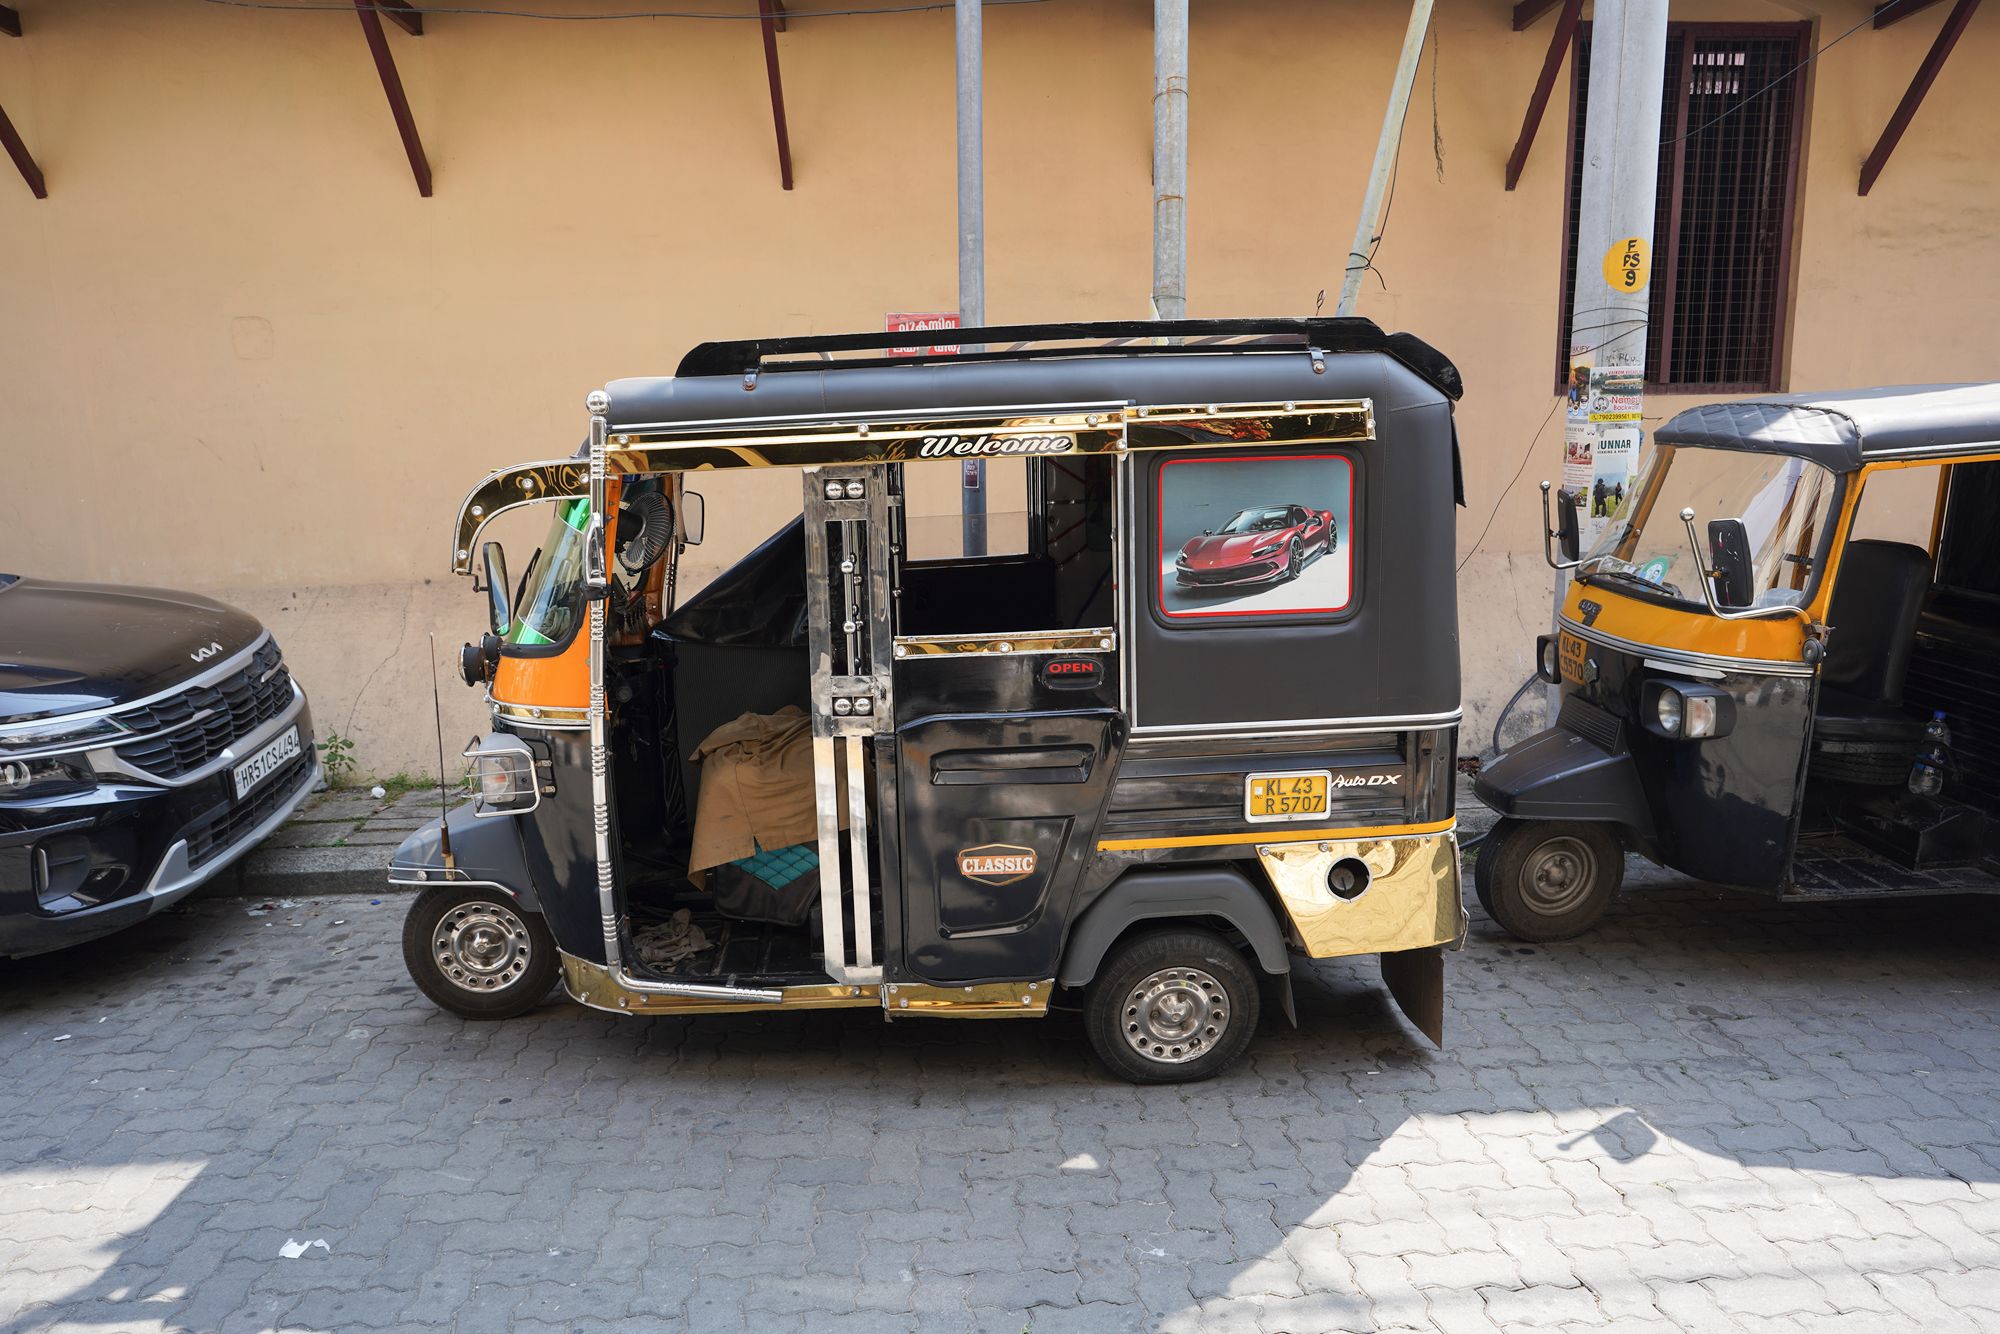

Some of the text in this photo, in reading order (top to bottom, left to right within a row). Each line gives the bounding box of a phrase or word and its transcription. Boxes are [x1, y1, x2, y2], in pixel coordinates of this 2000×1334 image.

[1627, 239, 1637, 251] F
[1623, 253, 1640, 267] PS
[1625, 270, 1636, 286] 9
[920, 434, 1072, 457] Welcome
[1048, 663, 1093, 673] OPEN
[241, 731, 300, 789] HR51CS4494
[1265, 778, 1313, 796] KL 43
[1331, 774, 1403, 789] Auto DX
[1266, 796, 1322, 813] R 5707
[961, 856, 1033, 873] CLASSIC
